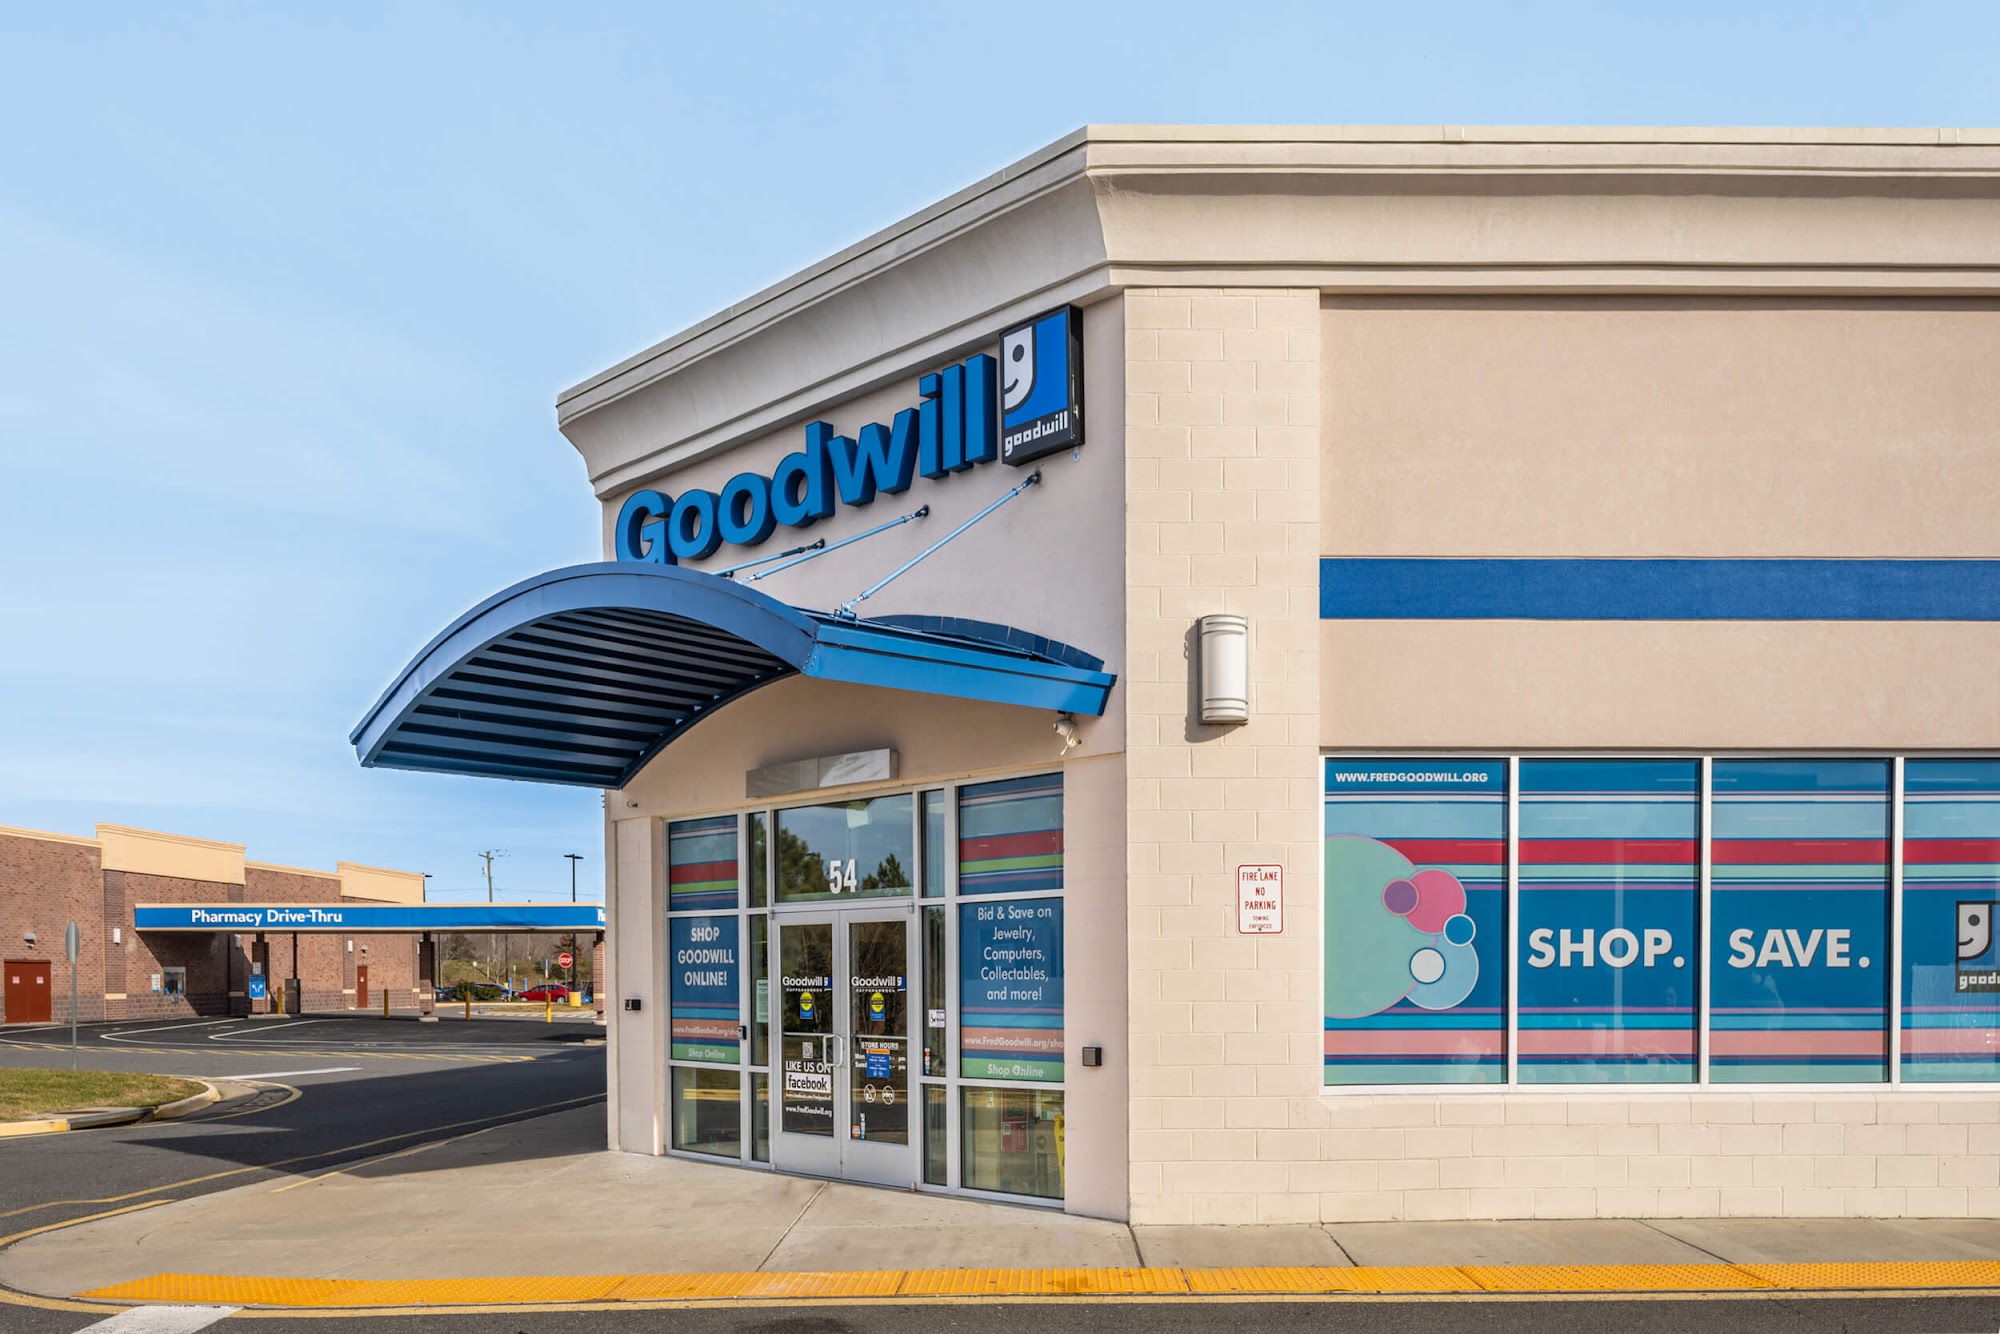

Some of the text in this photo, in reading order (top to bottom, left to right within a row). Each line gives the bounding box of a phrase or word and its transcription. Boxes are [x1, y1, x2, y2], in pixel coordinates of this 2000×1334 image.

[1004, 410, 1068, 457] goodwill
[615, 352, 997, 566] Goodwill
[1335, 772, 1489, 783] WWW.FREDGOODWILL.ORG
[829, 858, 858, 895] 54
[1242, 871, 1278, 881] FIRE LANE
[1255, 886, 1266, 896] NO
[977, 905, 1052, 921] Bid & Save on
[1244, 900, 1277, 910] PARKING
[191, 909, 343, 926] Pharmacy Drive-Thru
[690, 926, 720, 942] SHOP
[992, 924, 1036, 943] Jewelry,
[983, 946, 1046, 963] Computers,
[1527, 928, 1685, 969] SHOP.
[1727, 928, 1871, 969] SAVE.
[677, 949, 735, 965] GOODWILL
[684, 970, 728, 987] ONLINE!
[782, 975, 823, 987] Goodwill
[851, 975, 896, 987] Goodwill
[980, 965, 1050, 983] Collectables,
[1959, 971, 2000, 991] good
[986, 985, 1043, 1001] and more!
[860, 1041, 899, 1050] STORE HOURS
[687, 1048, 726, 1060] Shop Online
[785, 1060, 832, 1074] LIKE US ON
[986, 1063, 1045, 1078] Shop Online
[787, 1074, 828, 1091] facebook
